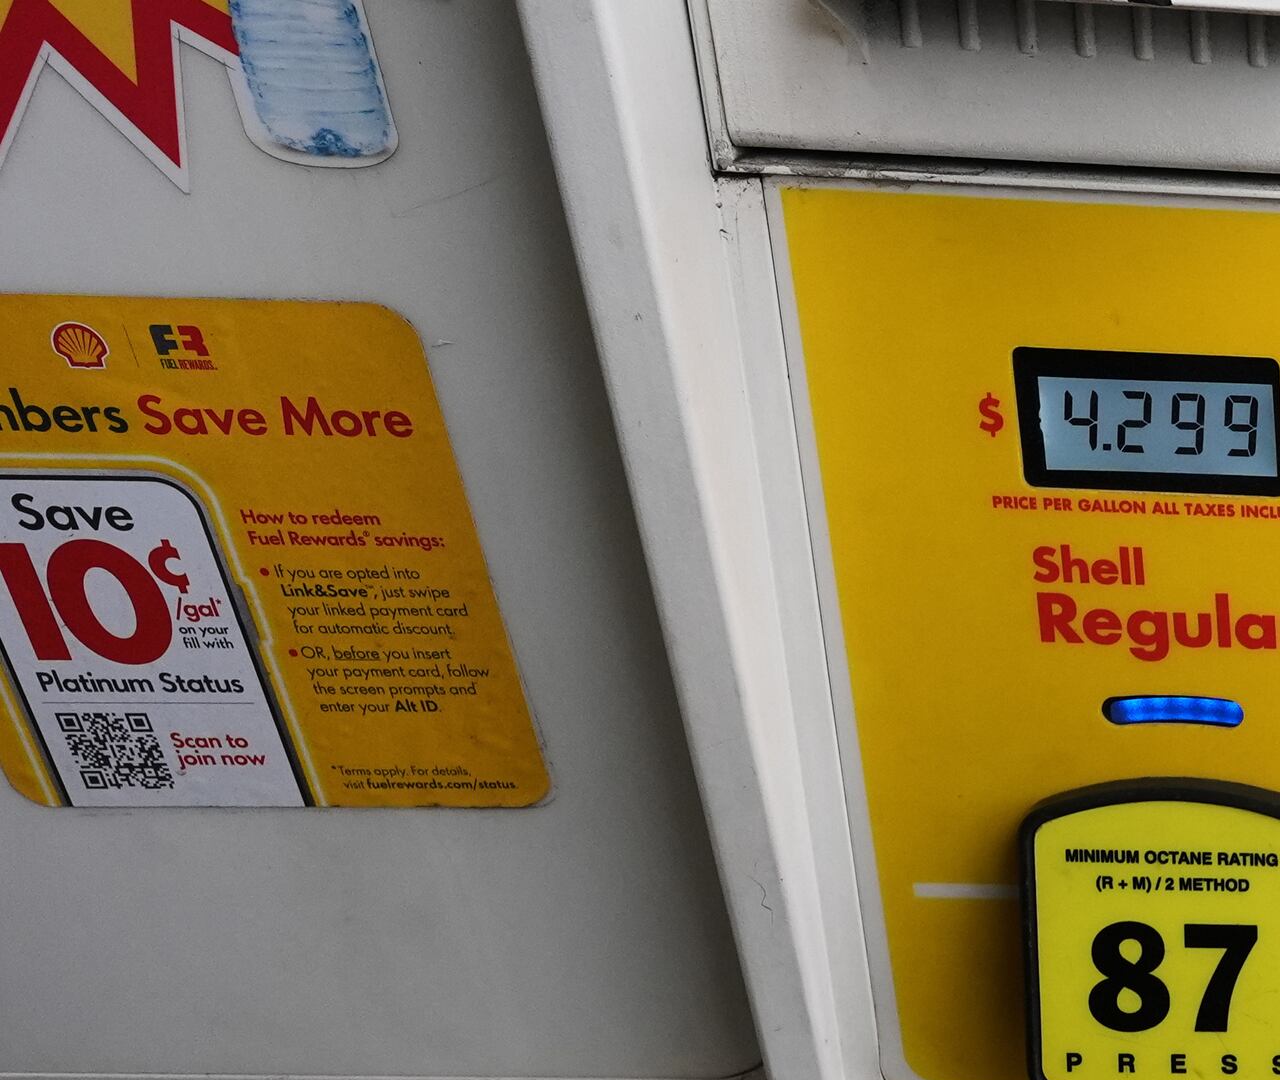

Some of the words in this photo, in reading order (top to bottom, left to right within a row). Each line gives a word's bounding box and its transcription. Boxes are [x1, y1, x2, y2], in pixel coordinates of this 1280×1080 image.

[0, 388, 129, 434] bers
[137, 395, 267, 436] Save
[280, 396, 413, 438] More
[978, 392, 1004, 437] $
[1063, 389, 1259, 458] 4.299
[11, 492, 134, 531] Save
[992, 495, 1037, 511] PRICE
[1043, 497, 1072, 512] PER
[1078, 498, 1146, 514] GALLON
[1152, 501, 1179, 516] ALL
[1185, 502, 1235, 518] TAXES
[240, 509, 284, 525] How
[289, 511, 308, 525] to
[312, 510, 381, 526] redeem
[247, 530, 284, 546] Fuel
[375, 532, 445, 551] savings:
[274, 564, 284, 578] If
[287, 569, 315, 582] you
[319, 569, 343, 579] are
[346, 565, 389, 583] opted
[392, 567, 420, 579] into
[1032, 544, 1146, 585] Shell
[380, 586, 405, 601] just
[409, 586, 450, 602] swipe
[287, 606, 319, 619] your
[322, 602, 366, 616] linked
[370, 605, 433, 620] payment
[436, 603, 468, 616] card
[178, 627, 197, 635] on
[198, 627, 229, 638] your
[293, 620, 314, 634] for
[318, 622, 389, 634] automatic
[393, 621, 456, 635] discount.
[182, 637, 200, 649] fill
[202, 637, 235, 649] with
[301, 646, 330, 661] OR,
[334, 647, 380, 661] before
[382, 651, 411, 663] you
[413, 648, 452, 660] insert
[36, 669, 155, 693] Platinum
[159, 673, 245, 693] Status
[307, 667, 338, 680] your
[343, 667, 405, 681] payment
[409, 665, 444, 679] card,
[446, 664, 489, 677] follow
[313, 682, 337, 695] the
[340, 685, 385, 695] screen
[389, 684, 446, 698] prompts
[449, 682, 477, 695] and
[320, 702, 355, 712] enter
[358, 703, 390, 716] your
[395, 700, 416, 712] Alt
[170, 732, 222, 748] Scan
[225, 734, 248, 748] to
[177, 750, 216, 770] join
[221, 754, 266, 766] now
[410, 765, 428, 776] For
[343, 780, 364, 789] visit
[1065, 849, 1139, 863] MINIMUM
[1144, 851, 1213, 865] OCTANE
[1217, 853, 1279, 867] RATING
[1095, 875, 1114, 892] (R
[1118, 880, 1128, 889] +
[1132, 876, 1152, 893] M)
[1155, 877, 1161, 891] /
[1165, 877, 1175, 890] 2
[1179, 878, 1250, 892] METHOD
[1088, 921, 1258, 1032] 87
